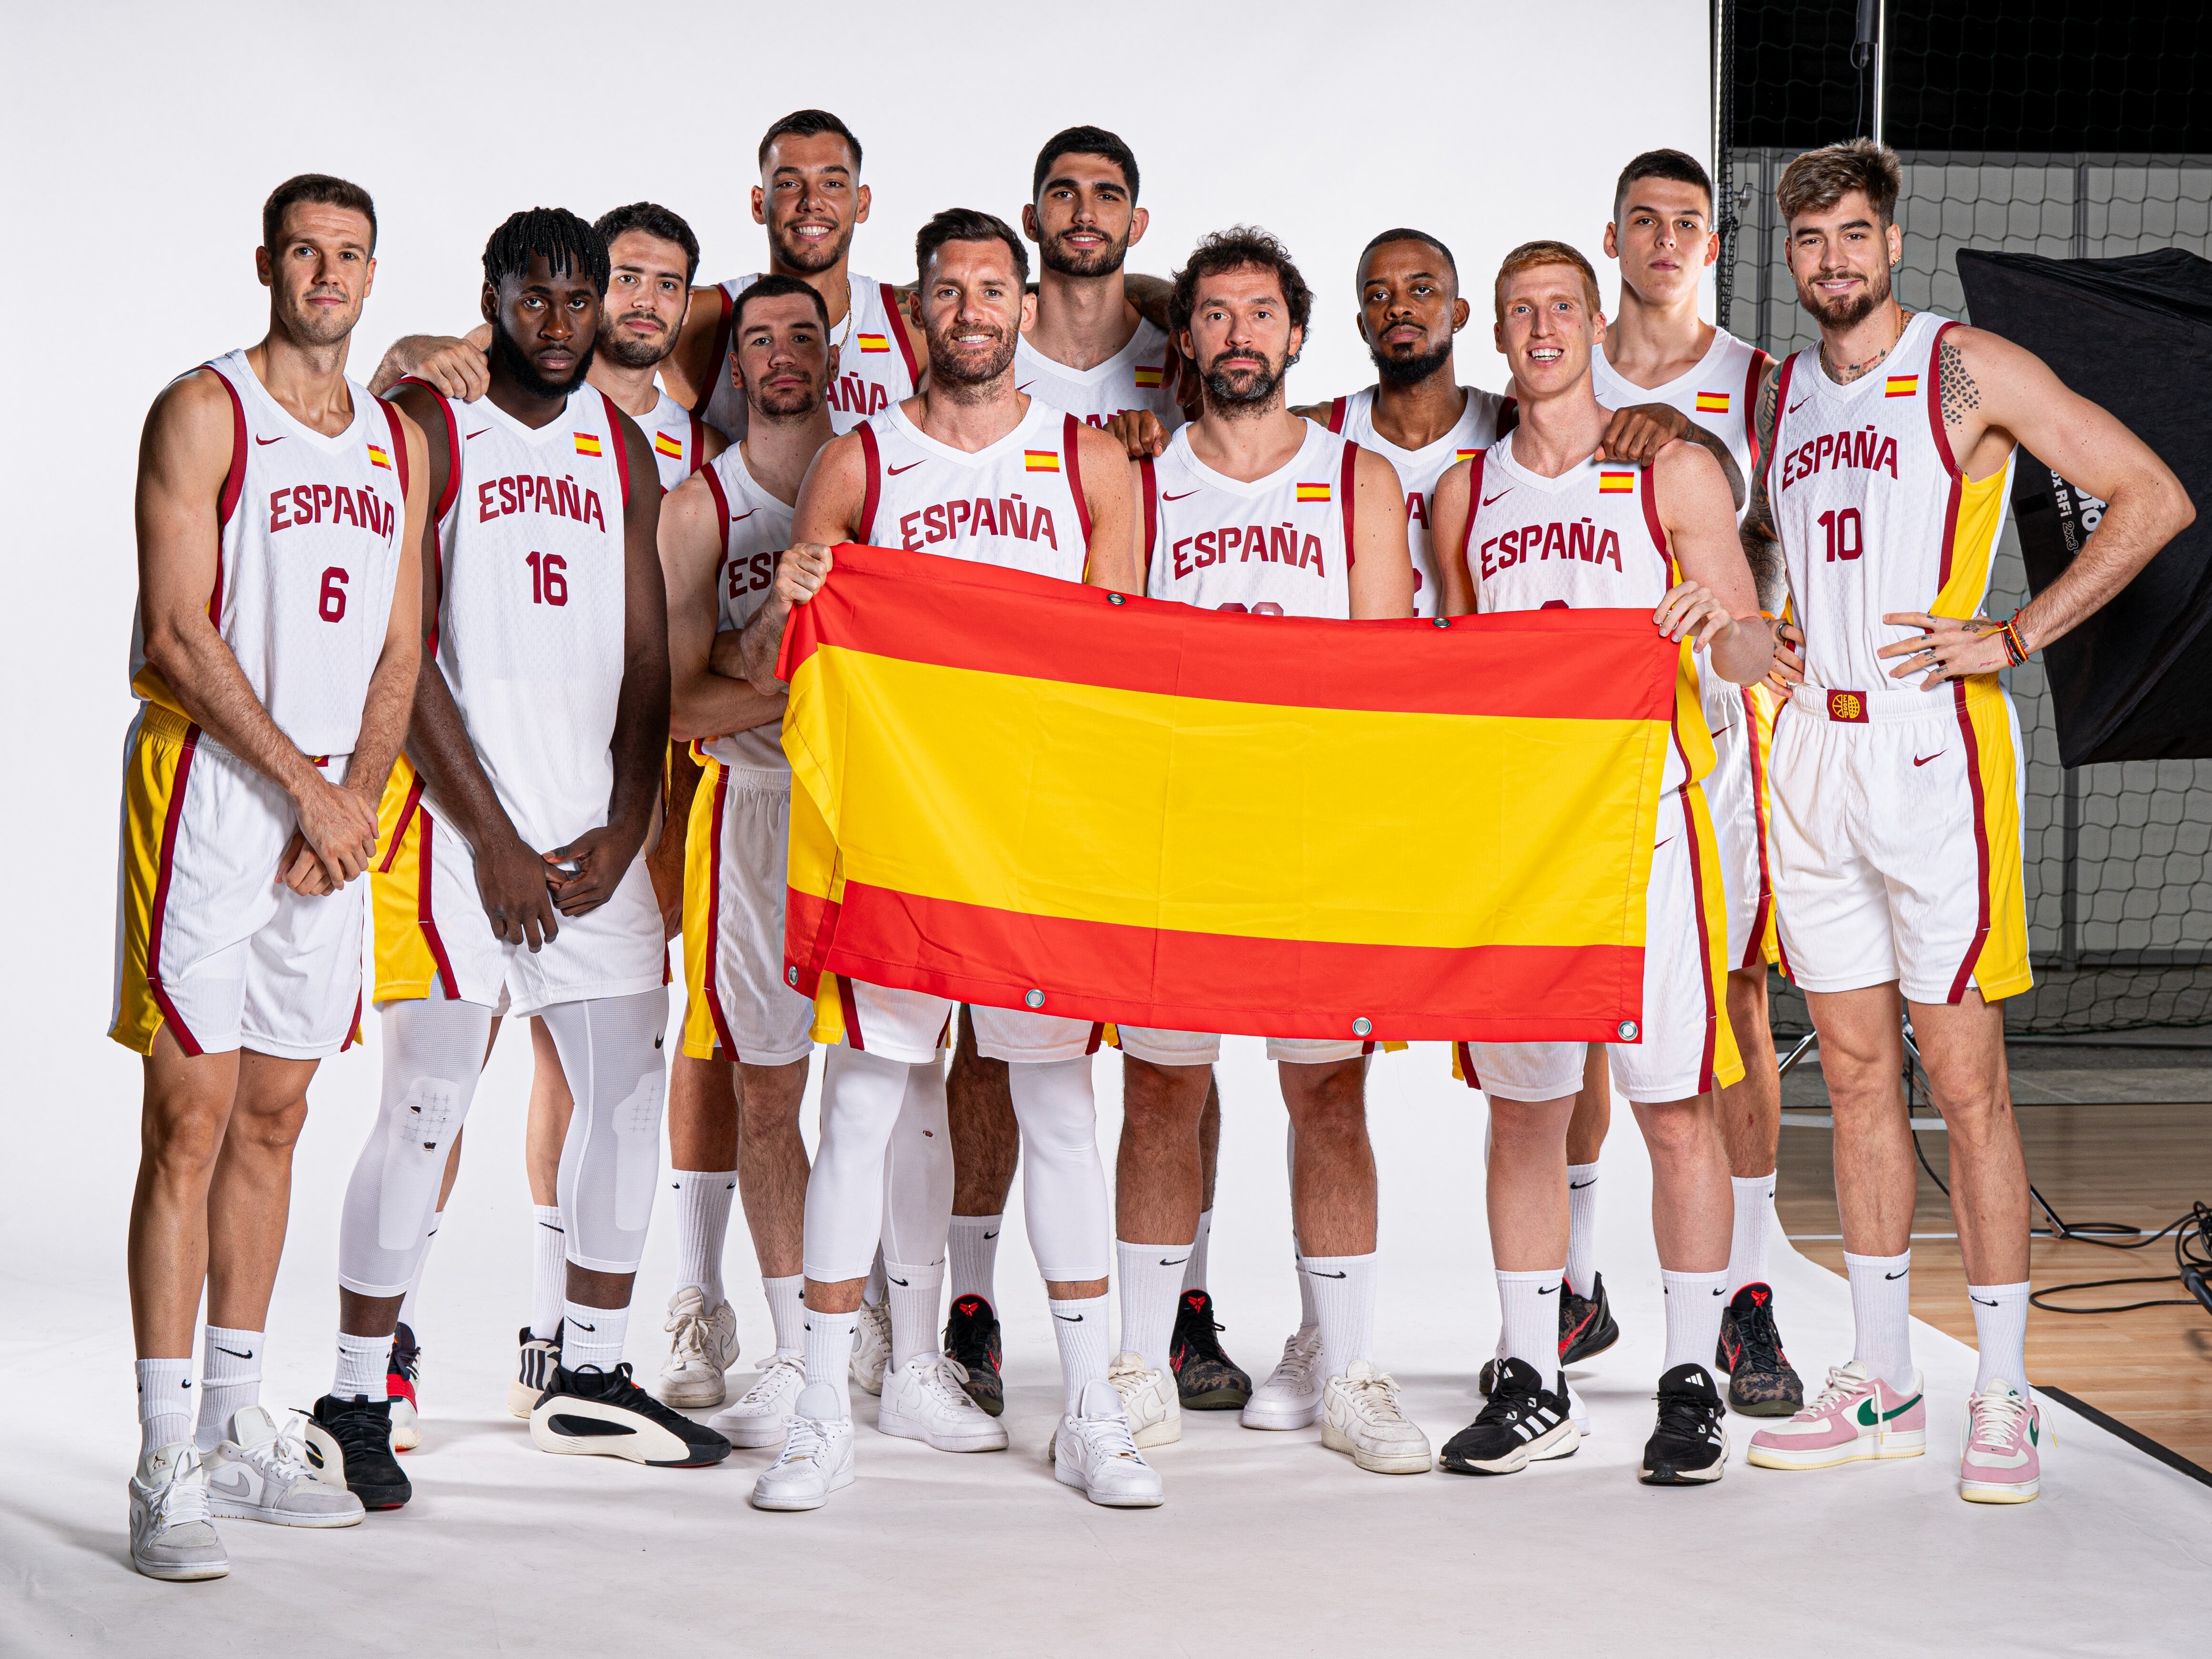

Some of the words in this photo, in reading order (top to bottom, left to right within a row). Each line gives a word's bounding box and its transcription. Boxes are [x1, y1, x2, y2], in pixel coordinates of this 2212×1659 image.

[1782, 424, 1898, 491] ESPAÑA
[270, 484, 394, 549] ESPAÑA
[479, 474, 605, 533] ESPAÑA
[900, 493, 1057, 552] ESPAÑA
[2055, 489, 2072, 517] RFi
[1173, 522, 1325, 580] ESPAÑA
[1481, 517, 1622, 582] ESPAÑA
[1817, 508, 1863, 562] 10
[319, 566, 349, 623] 6
[525, 551, 568, 606] 16
